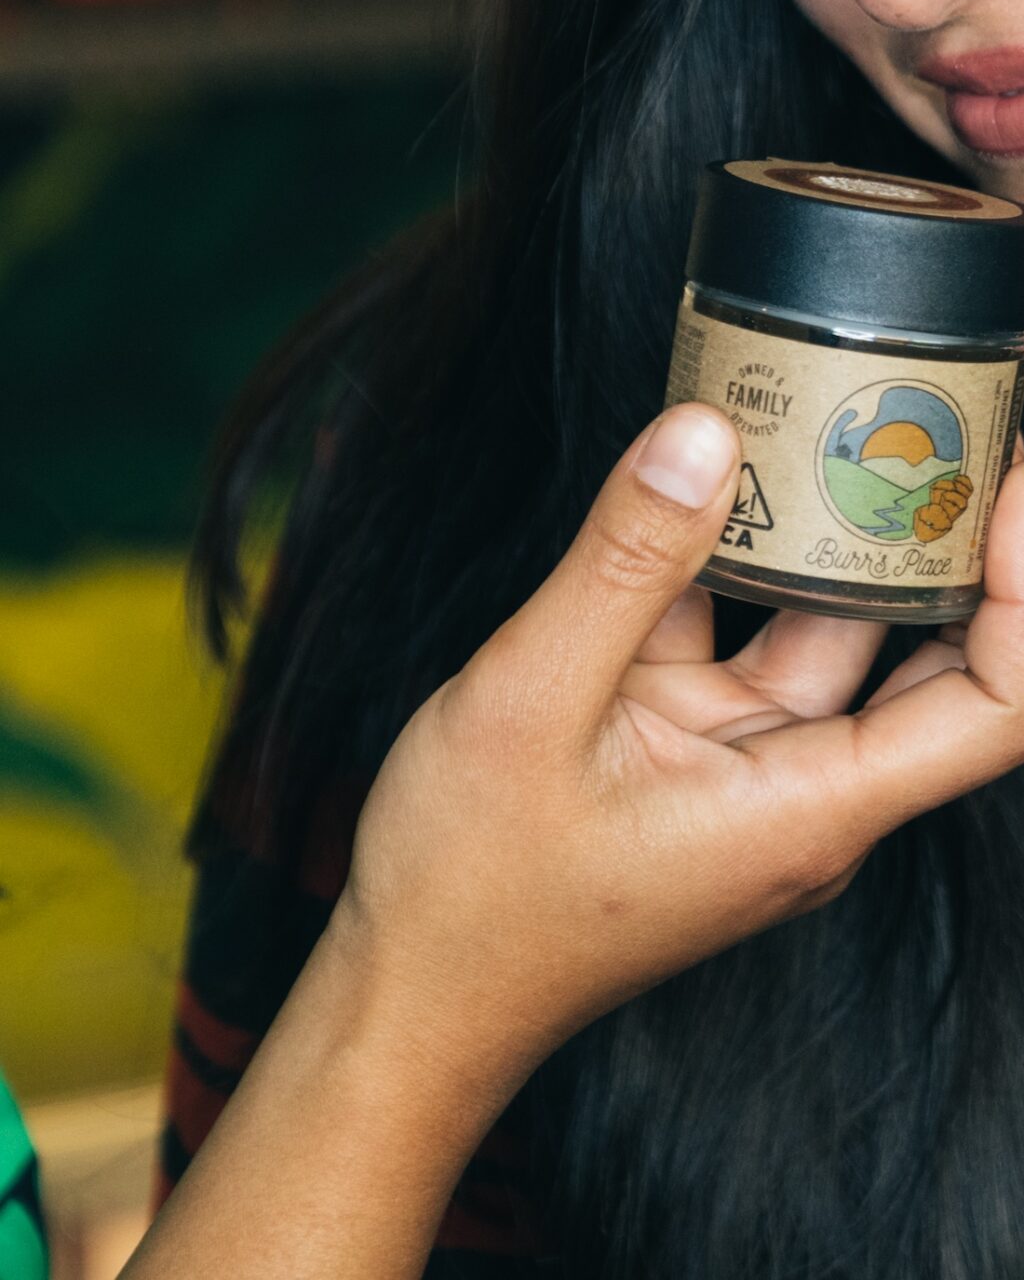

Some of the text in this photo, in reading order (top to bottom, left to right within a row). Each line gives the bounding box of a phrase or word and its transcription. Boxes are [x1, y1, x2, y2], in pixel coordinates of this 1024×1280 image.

[738, 363, 775, 379] OWNED
[726, 380, 793, 418] FAMILY
[730, 412, 779, 437] OPERATED
[720, 524, 753, 551] CA
[805, 537, 890, 579] Burr's
[894, 548, 952, 577] Place
